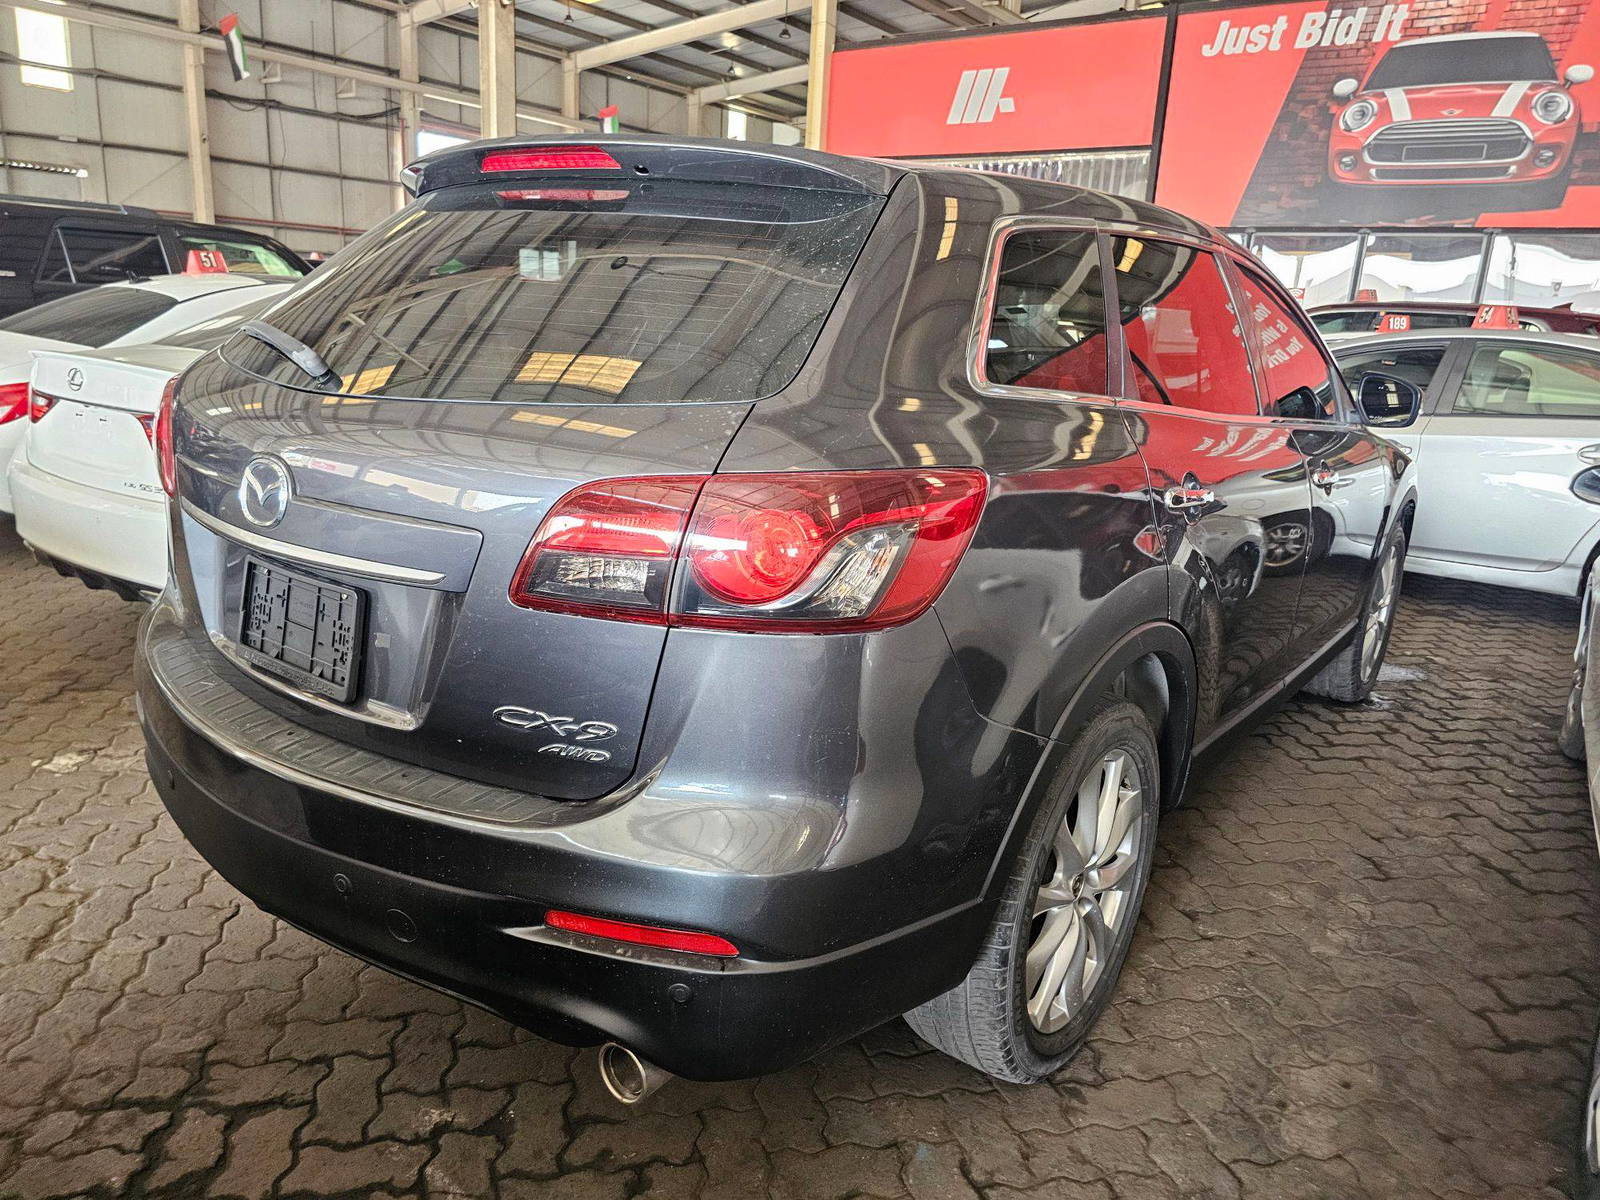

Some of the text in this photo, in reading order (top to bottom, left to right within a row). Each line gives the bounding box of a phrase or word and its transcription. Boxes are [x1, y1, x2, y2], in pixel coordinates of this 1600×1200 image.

[1201, 4, 1410, 57] Just Bid It
[199, 251, 217, 268] 51
[1389, 317, 1407, 330] 189
[492, 705, 618, 741] CX-9
[538, 743, 611, 762] AWD
